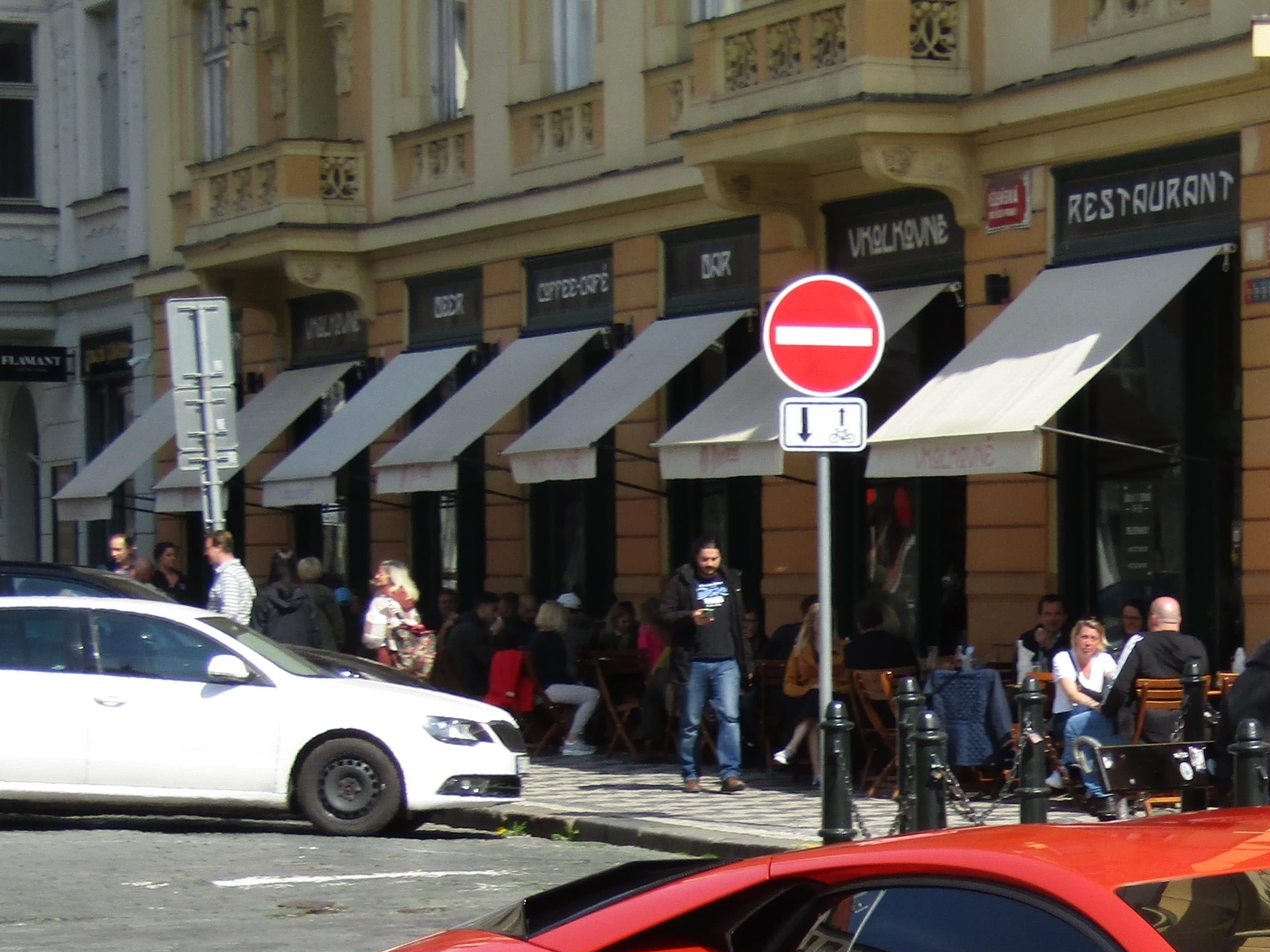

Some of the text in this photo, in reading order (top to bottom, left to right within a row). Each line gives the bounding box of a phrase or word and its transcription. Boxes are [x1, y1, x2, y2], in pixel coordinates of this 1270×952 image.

[1068, 170, 1234, 225] RESTAURANT
[701, 250, 732, 280] BAR
[1, 355, 61, 366] FLAMANT
